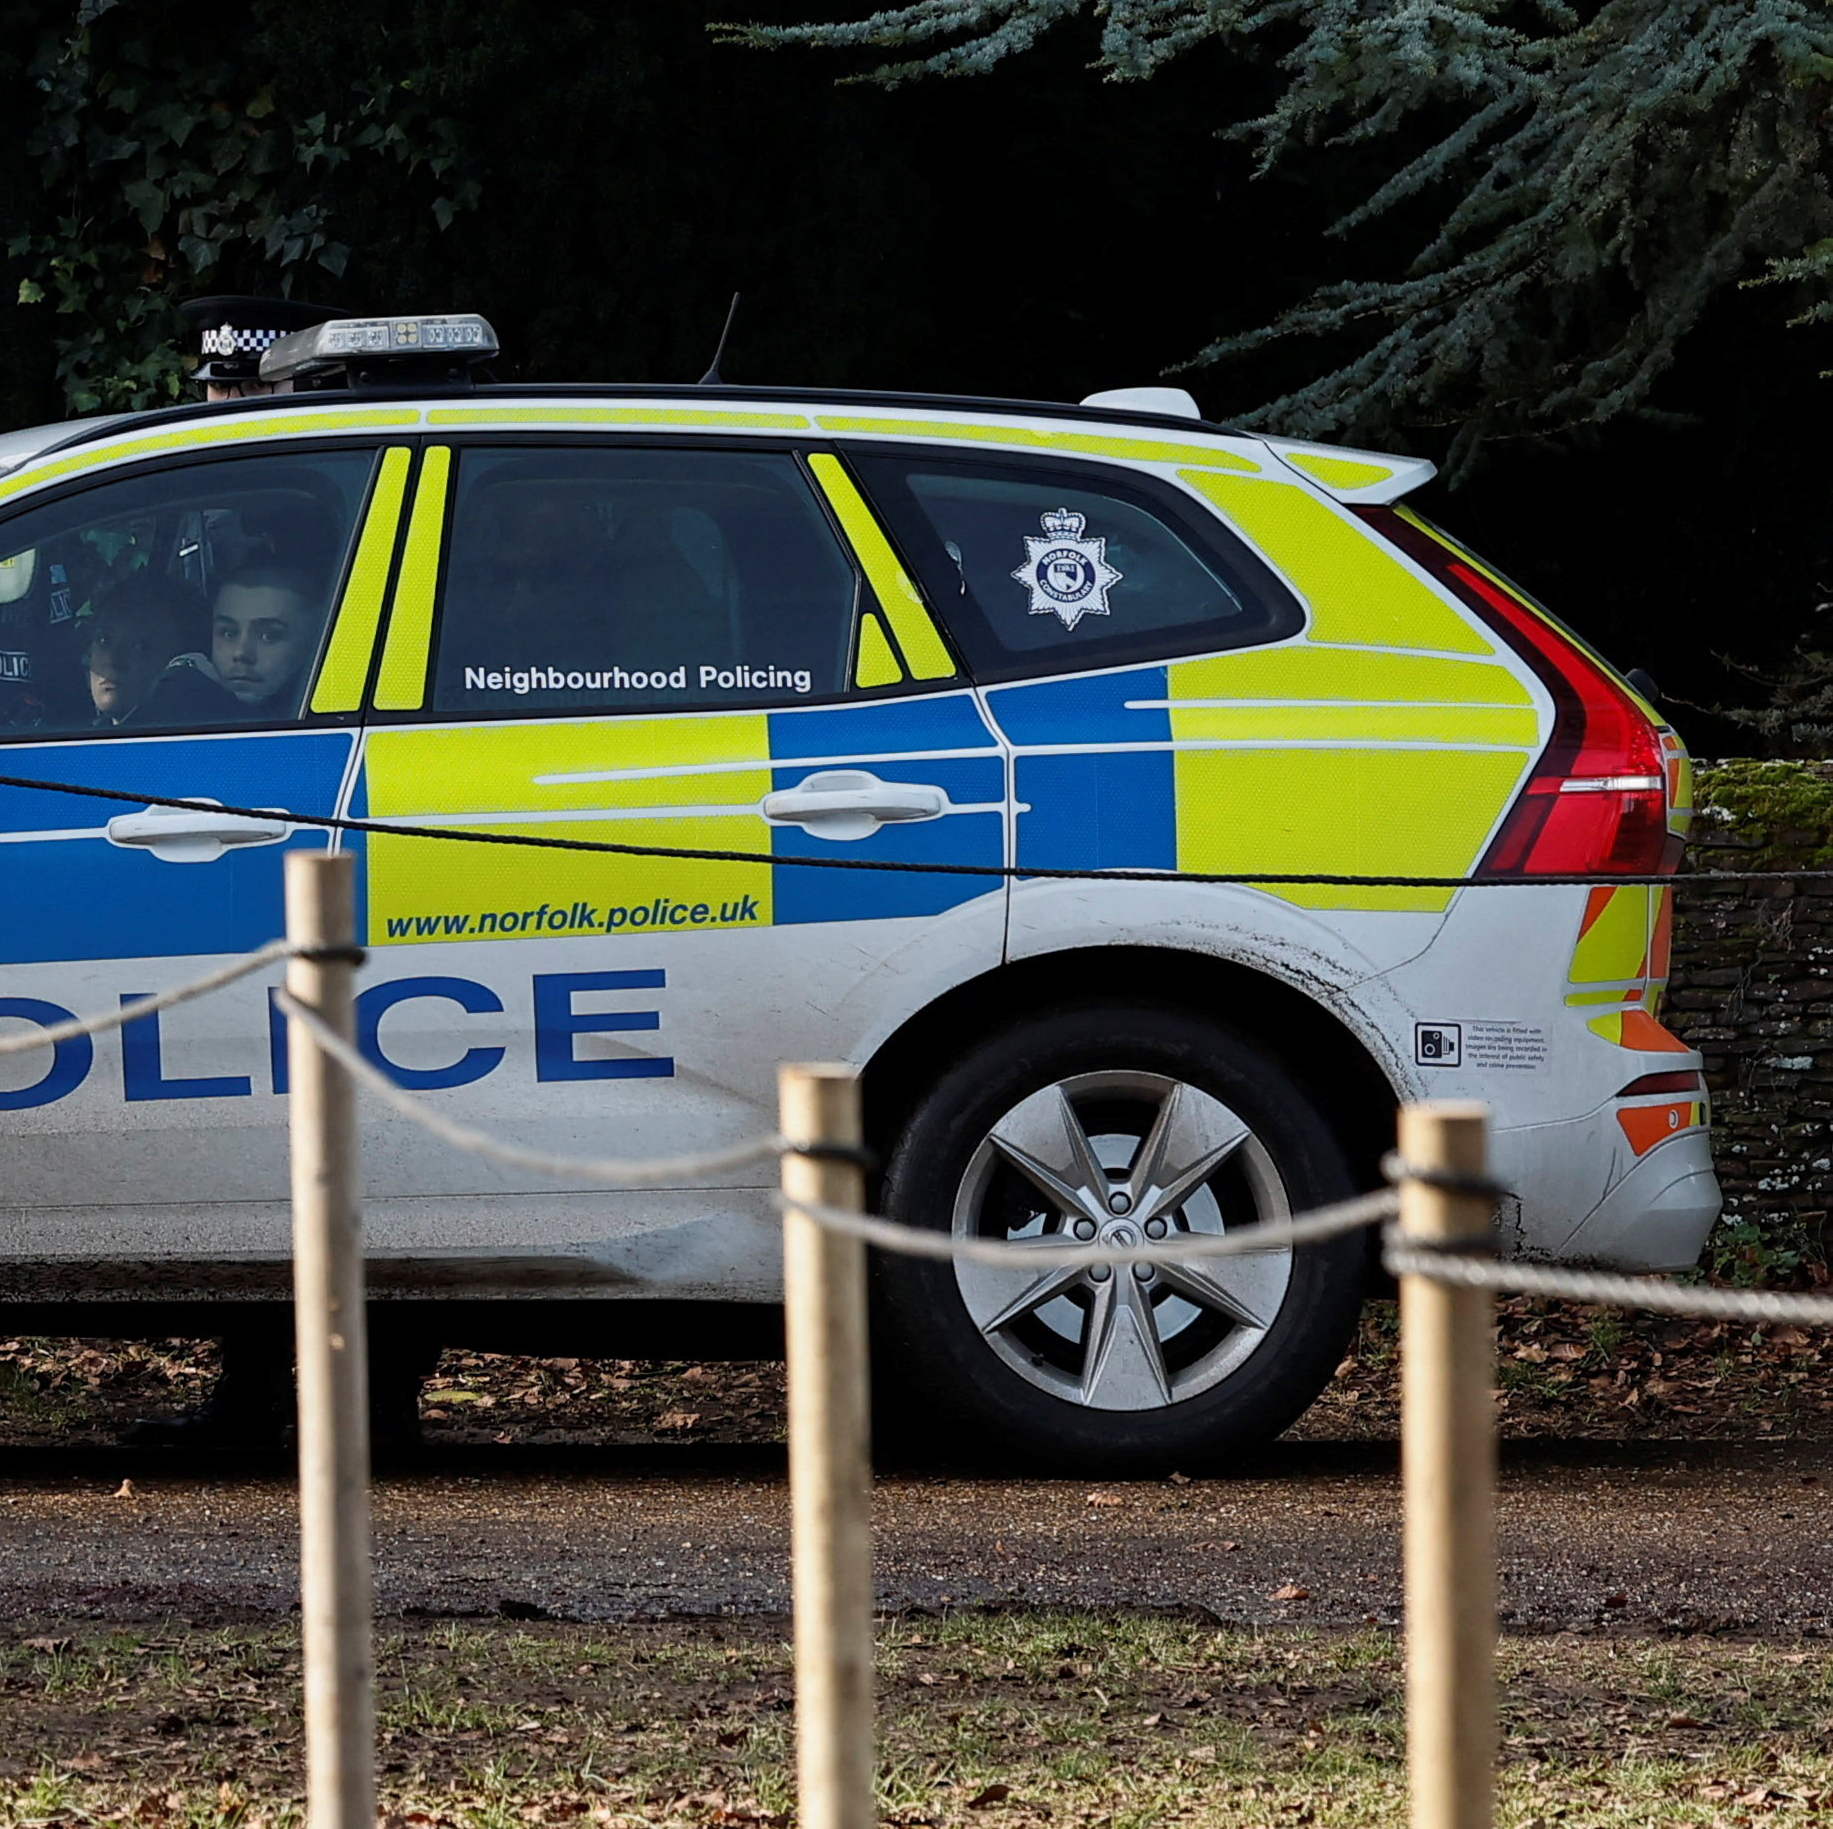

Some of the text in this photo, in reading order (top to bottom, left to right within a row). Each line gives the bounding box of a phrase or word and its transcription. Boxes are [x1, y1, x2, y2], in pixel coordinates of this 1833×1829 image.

[1042, 550, 1088, 565] NORFOLK
[1039, 579, 1093, 602] CONSTABULARY
[464, 665, 812, 694] Neighbourhood Policing
[386, 894, 760, 937] www.norfolk.police.uk
